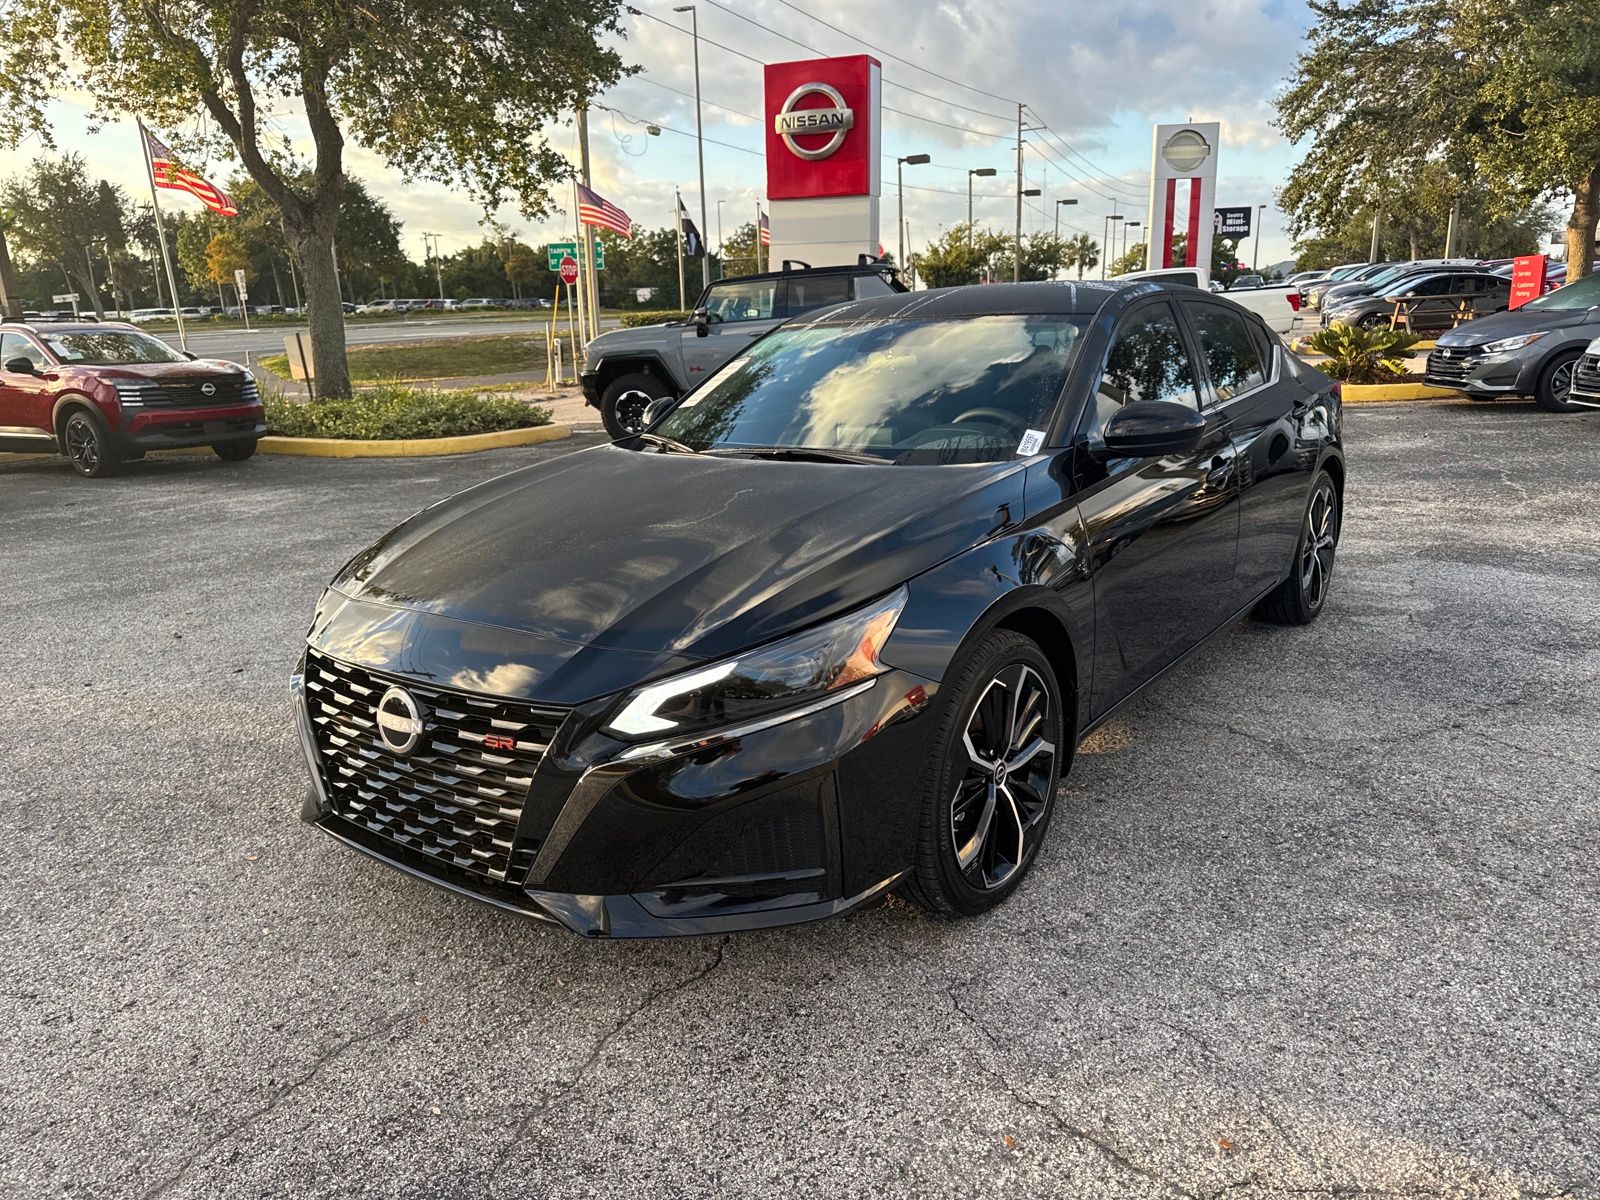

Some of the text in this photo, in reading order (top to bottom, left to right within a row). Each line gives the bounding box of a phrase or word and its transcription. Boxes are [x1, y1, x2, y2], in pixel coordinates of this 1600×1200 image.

[781, 112, 844, 129] NISSAN
[561, 264, 577, 276] STOP
[378, 710, 421, 733] ISSAN
[484, 733, 514, 751] SR
